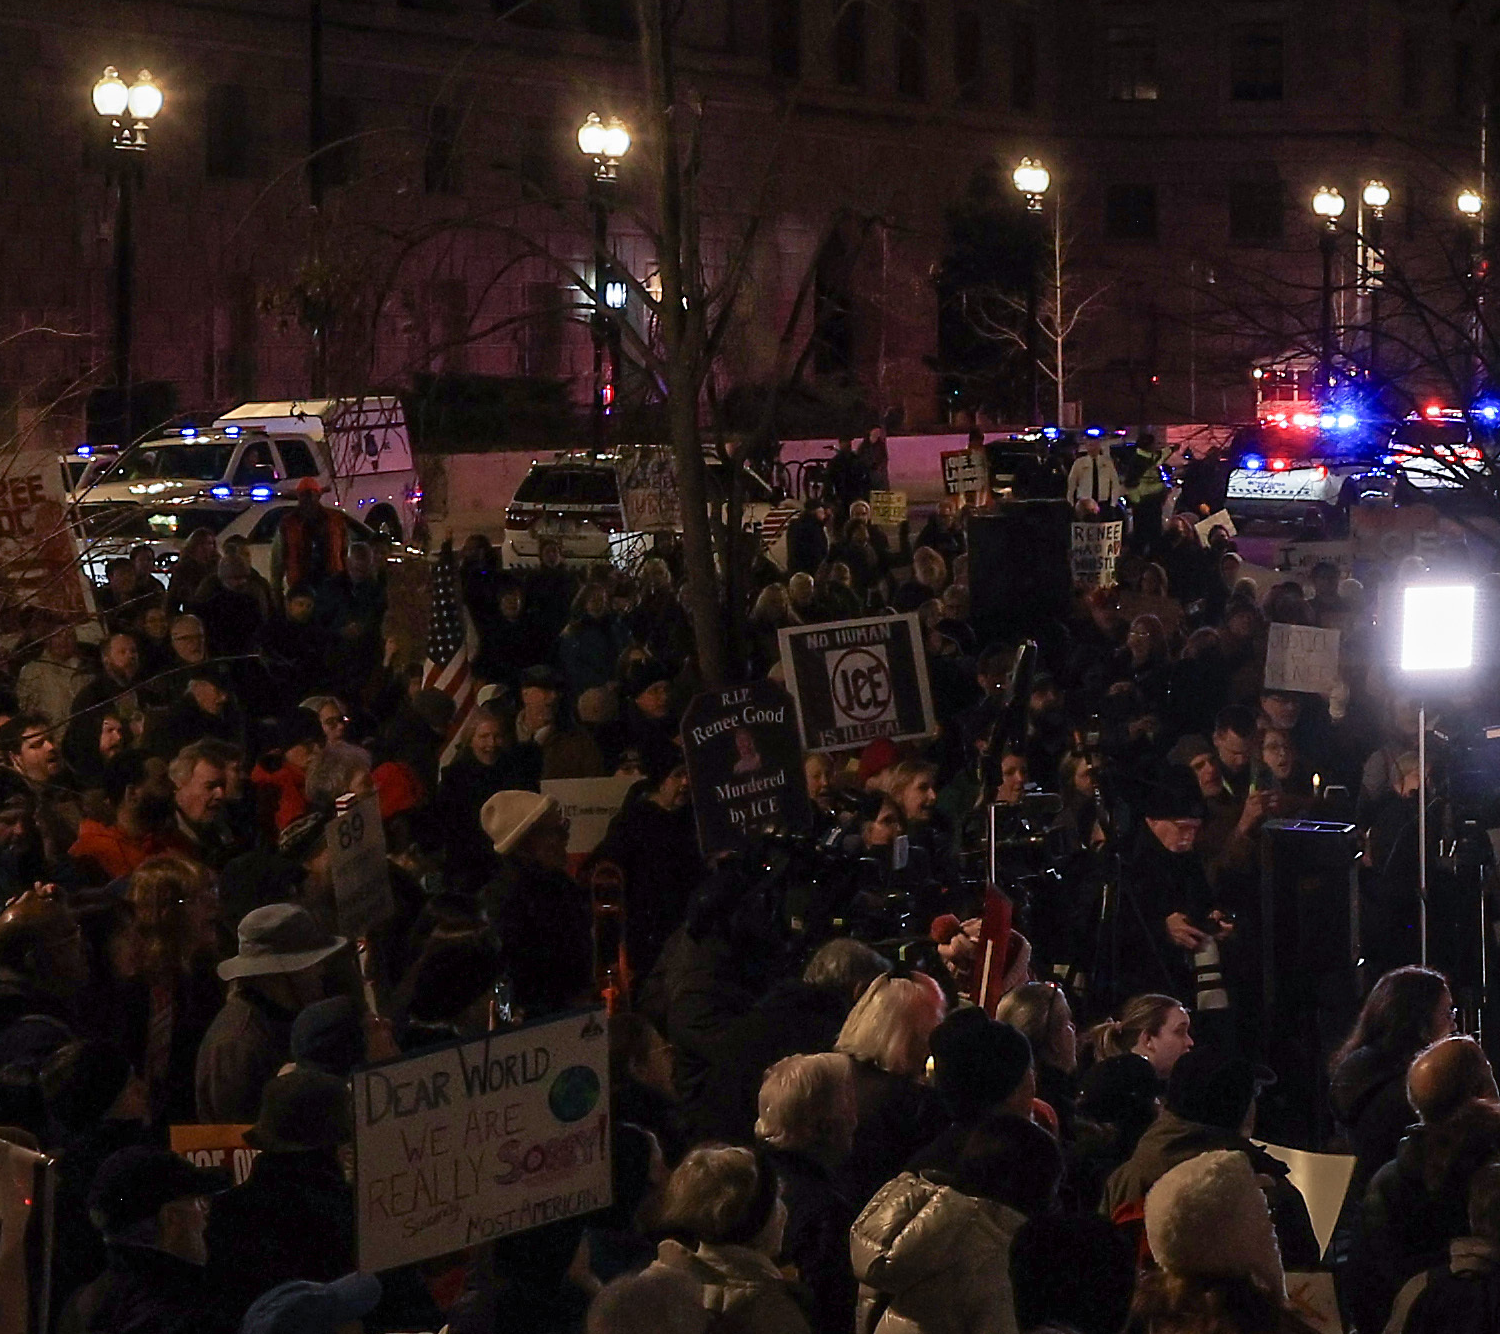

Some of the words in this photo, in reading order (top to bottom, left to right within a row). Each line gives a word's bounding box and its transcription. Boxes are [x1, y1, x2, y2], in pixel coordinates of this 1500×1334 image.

[1075, 524, 1121, 542] RENEE
[806, 633, 830, 650] NO
[835, 622, 893, 645] HUMAN
[720, 687, 751, 707] R.I.P.
[841, 666, 888, 711] ICE
[690, 715, 740, 746] Renee
[741, 705, 785, 729] Good
[819, 729, 838, 748] IS
[842, 720, 906, 744] ILLEGAL
[714, 769, 786, 804] Murdered
[336, 811, 365, 850] 89
[729, 806, 749, 835] by
[752, 795, 780, 820] ICE
[366, 1070, 451, 1126] DEAR
[457, 1037, 551, 1099] WORLD
[401, 1125, 450, 1164] WE
[465, 1102, 526, 1146] ARE
[493, 1113, 609, 1186] SORRY!
[368, 1153, 485, 1223] REALLY
[466, 1207, 518, 1245] MOST
